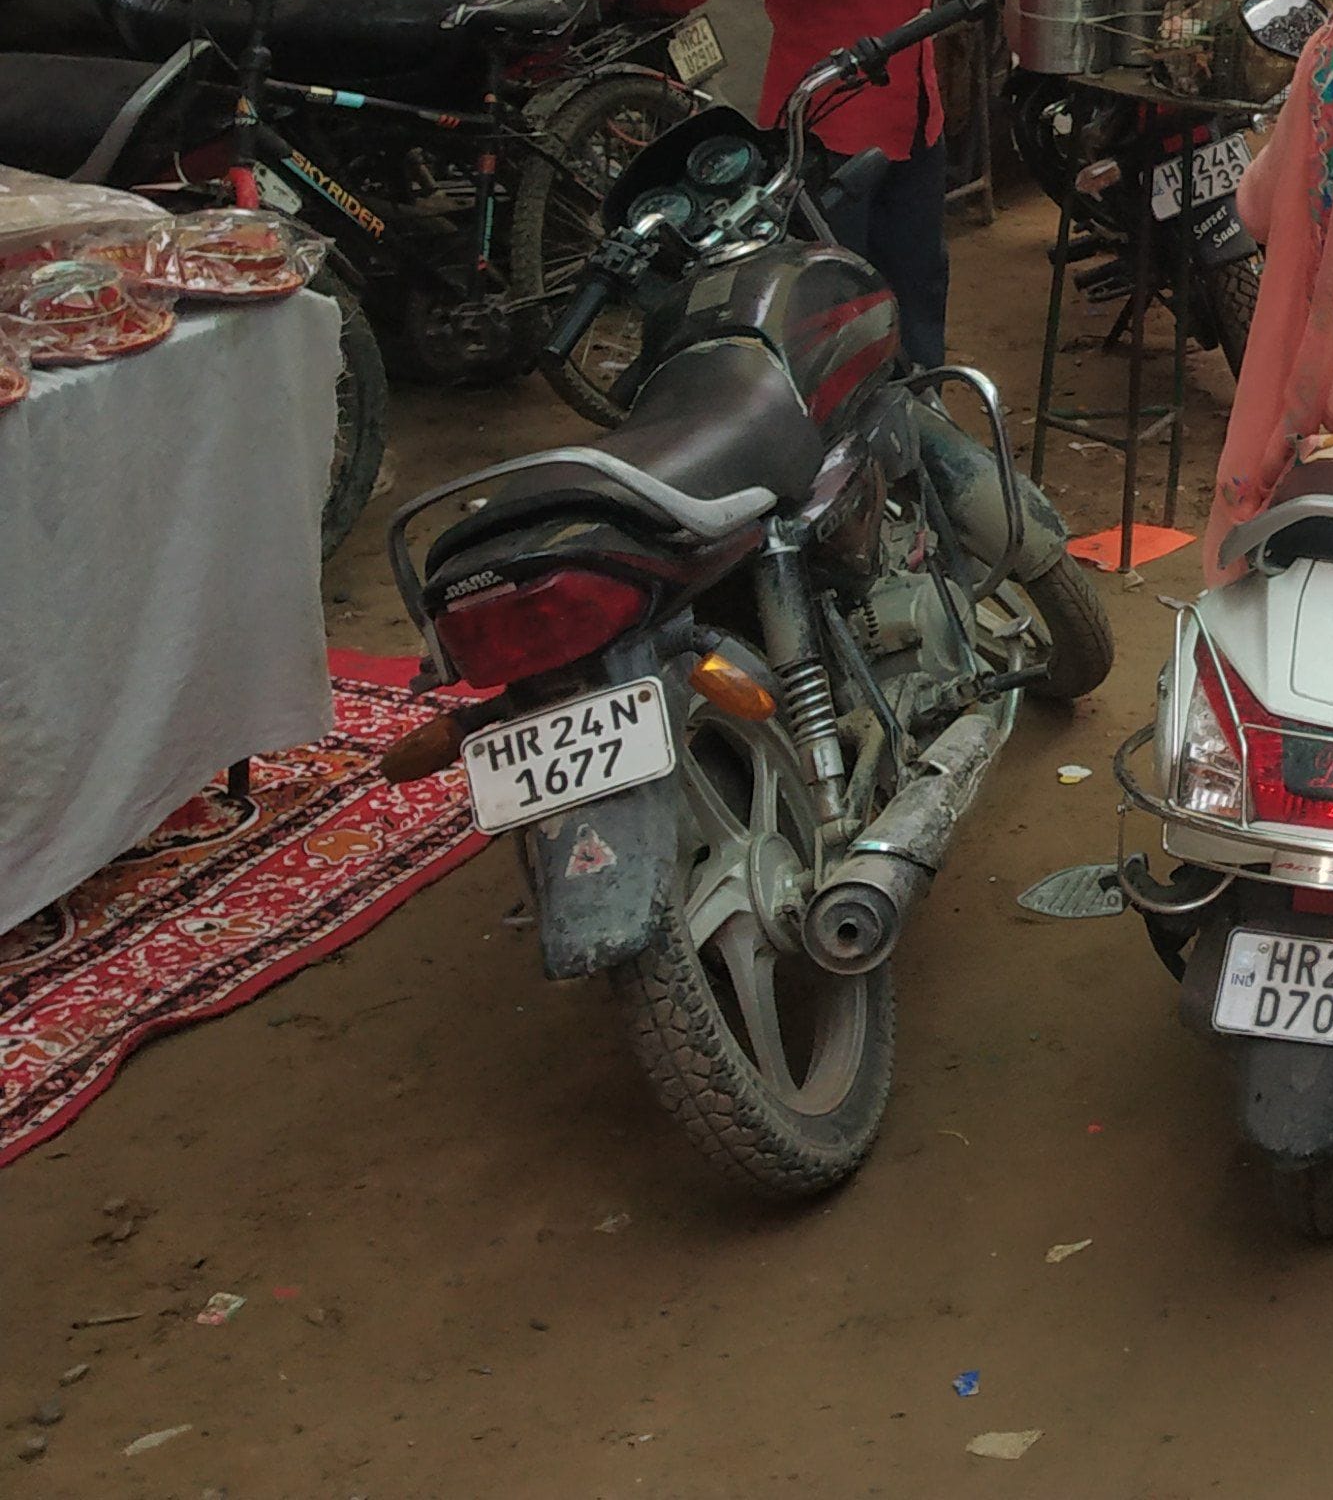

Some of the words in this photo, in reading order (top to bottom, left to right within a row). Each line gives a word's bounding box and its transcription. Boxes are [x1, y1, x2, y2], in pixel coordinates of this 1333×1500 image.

[1161, 141, 1240, 188] H24A
[515, 738, 623, 808] 1677
[1231, 972, 1256, 988] IND
